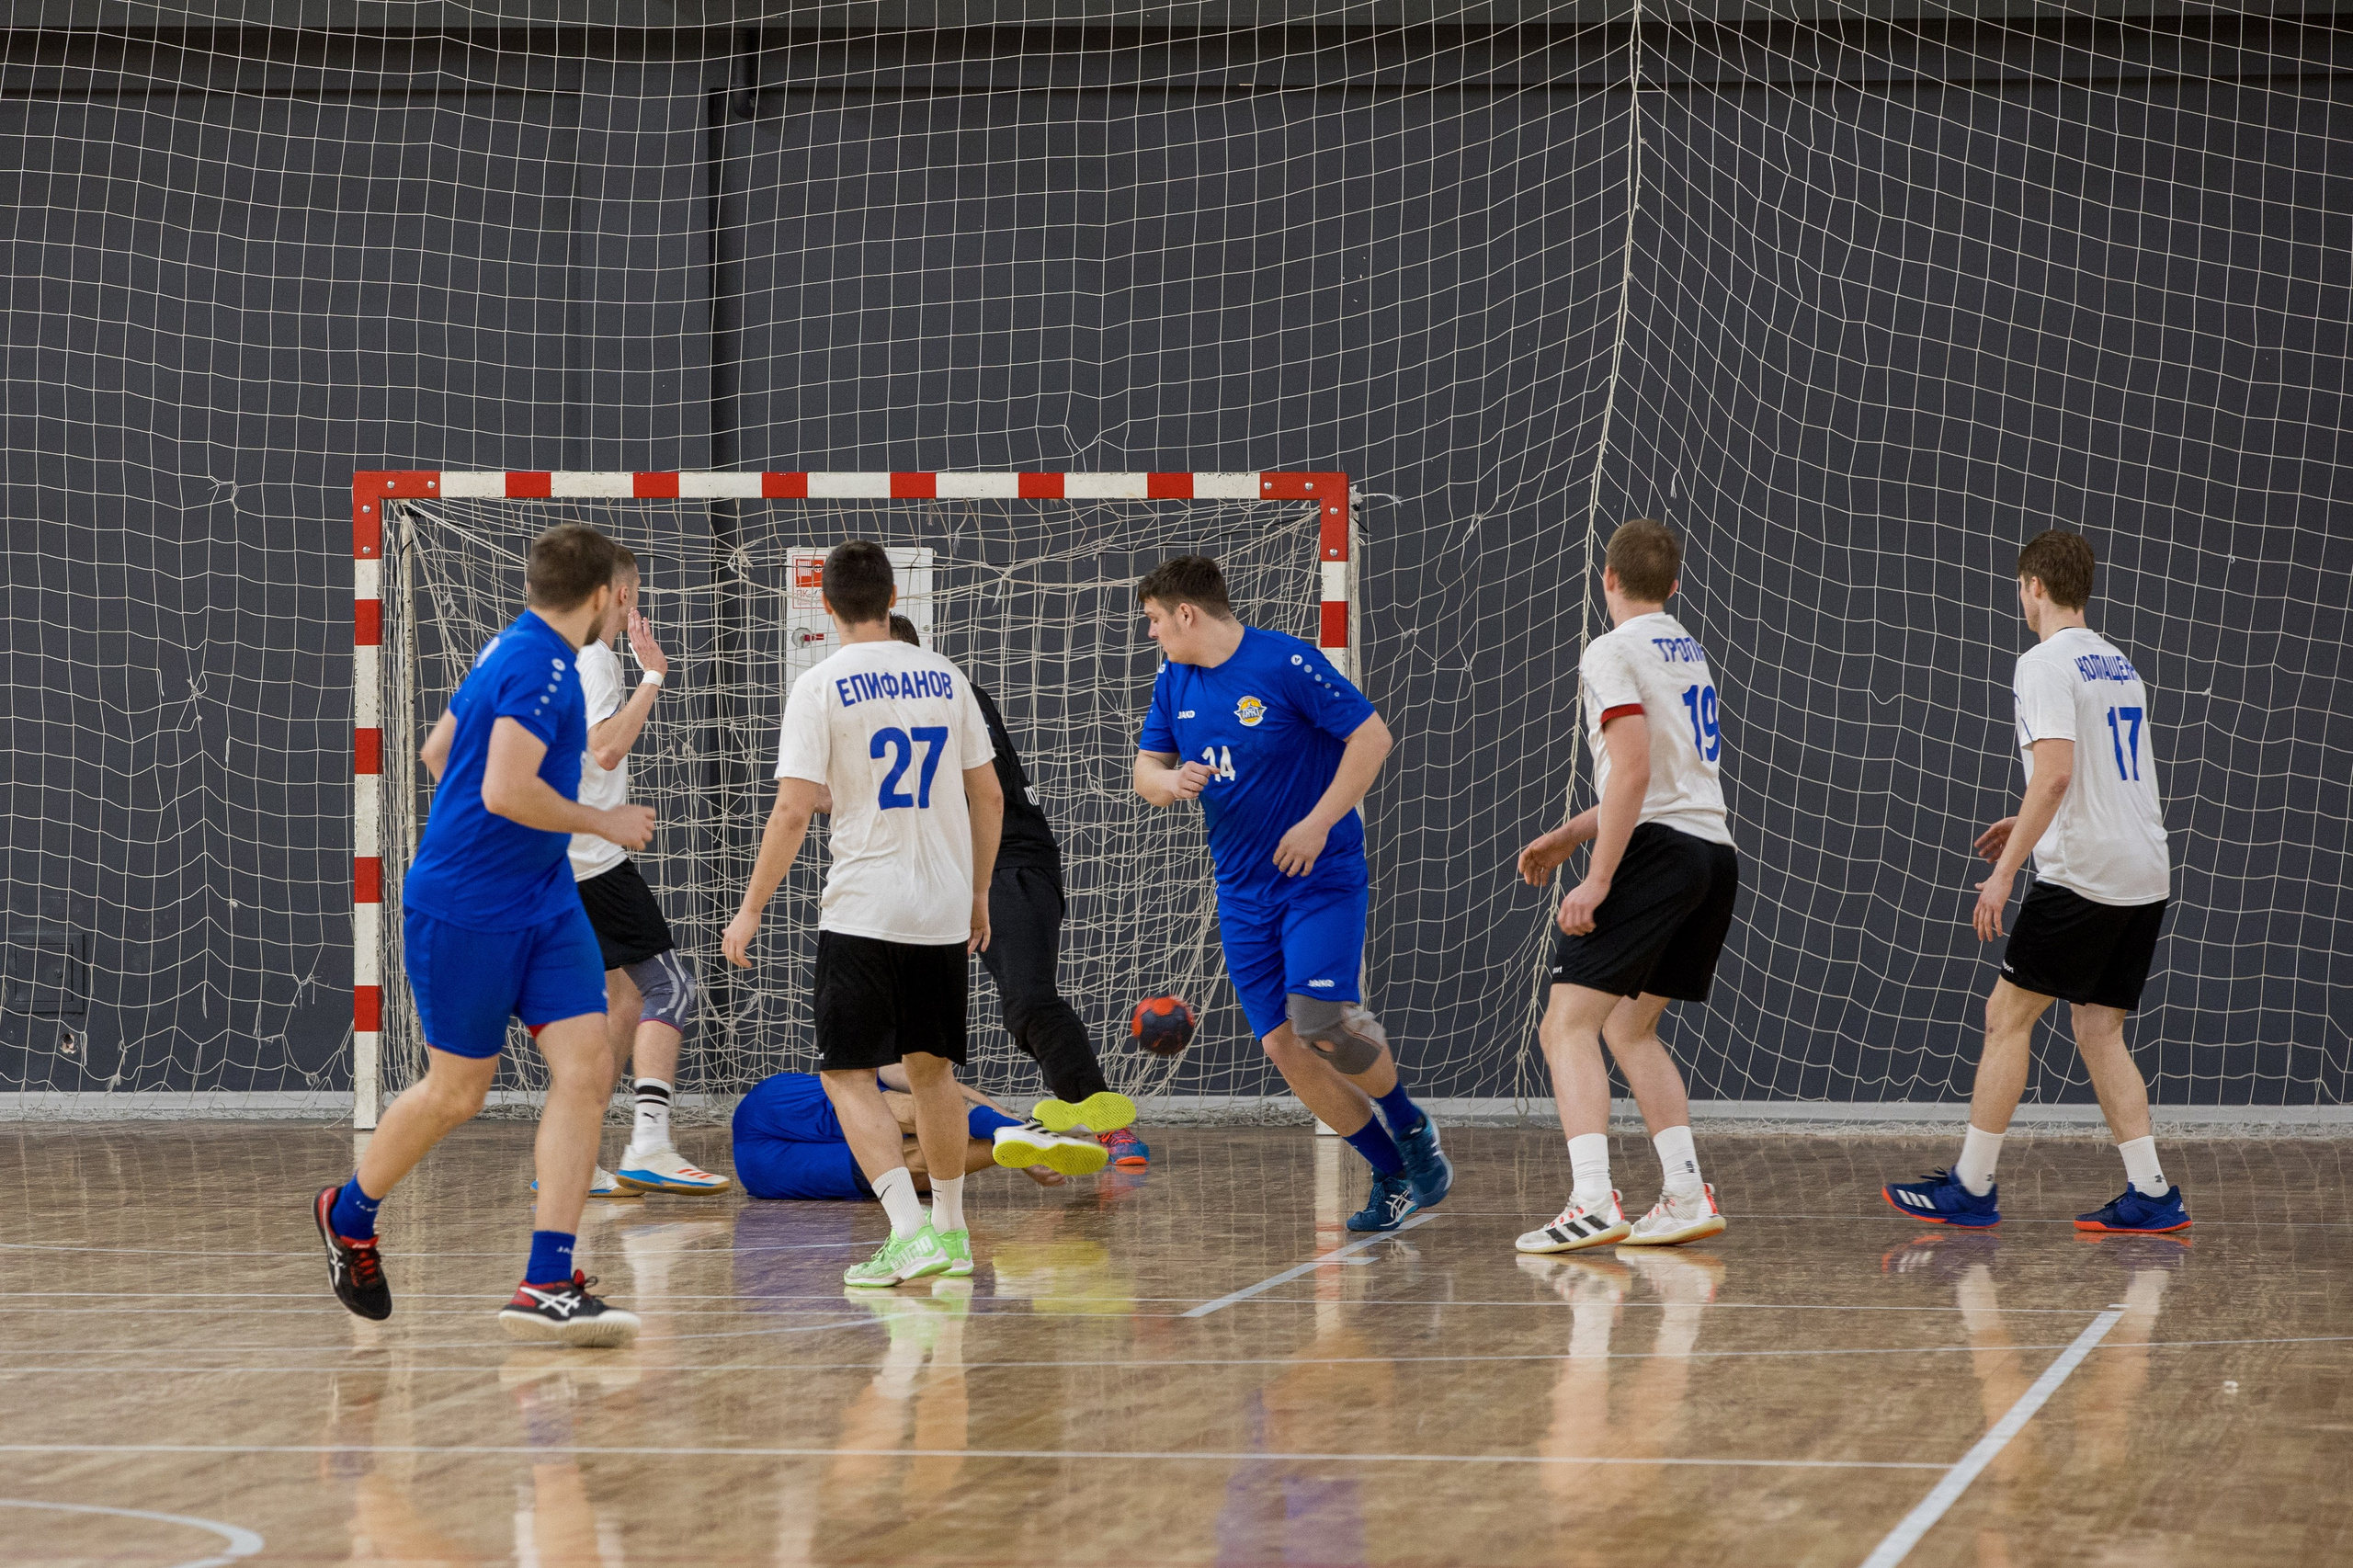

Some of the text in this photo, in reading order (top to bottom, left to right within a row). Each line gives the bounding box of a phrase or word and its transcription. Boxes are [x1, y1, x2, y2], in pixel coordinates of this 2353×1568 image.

[835, 670, 953, 707] ЕПИФАНОВ
[1177, 710, 1196, 719] JAKO
[1682, 685, 1721, 762] 19
[2107, 707, 2143, 781] 17
[870, 726, 949, 811] 27
[1201, 745, 1235, 782] 14
[1308, 979, 1335, 987] JAKO
